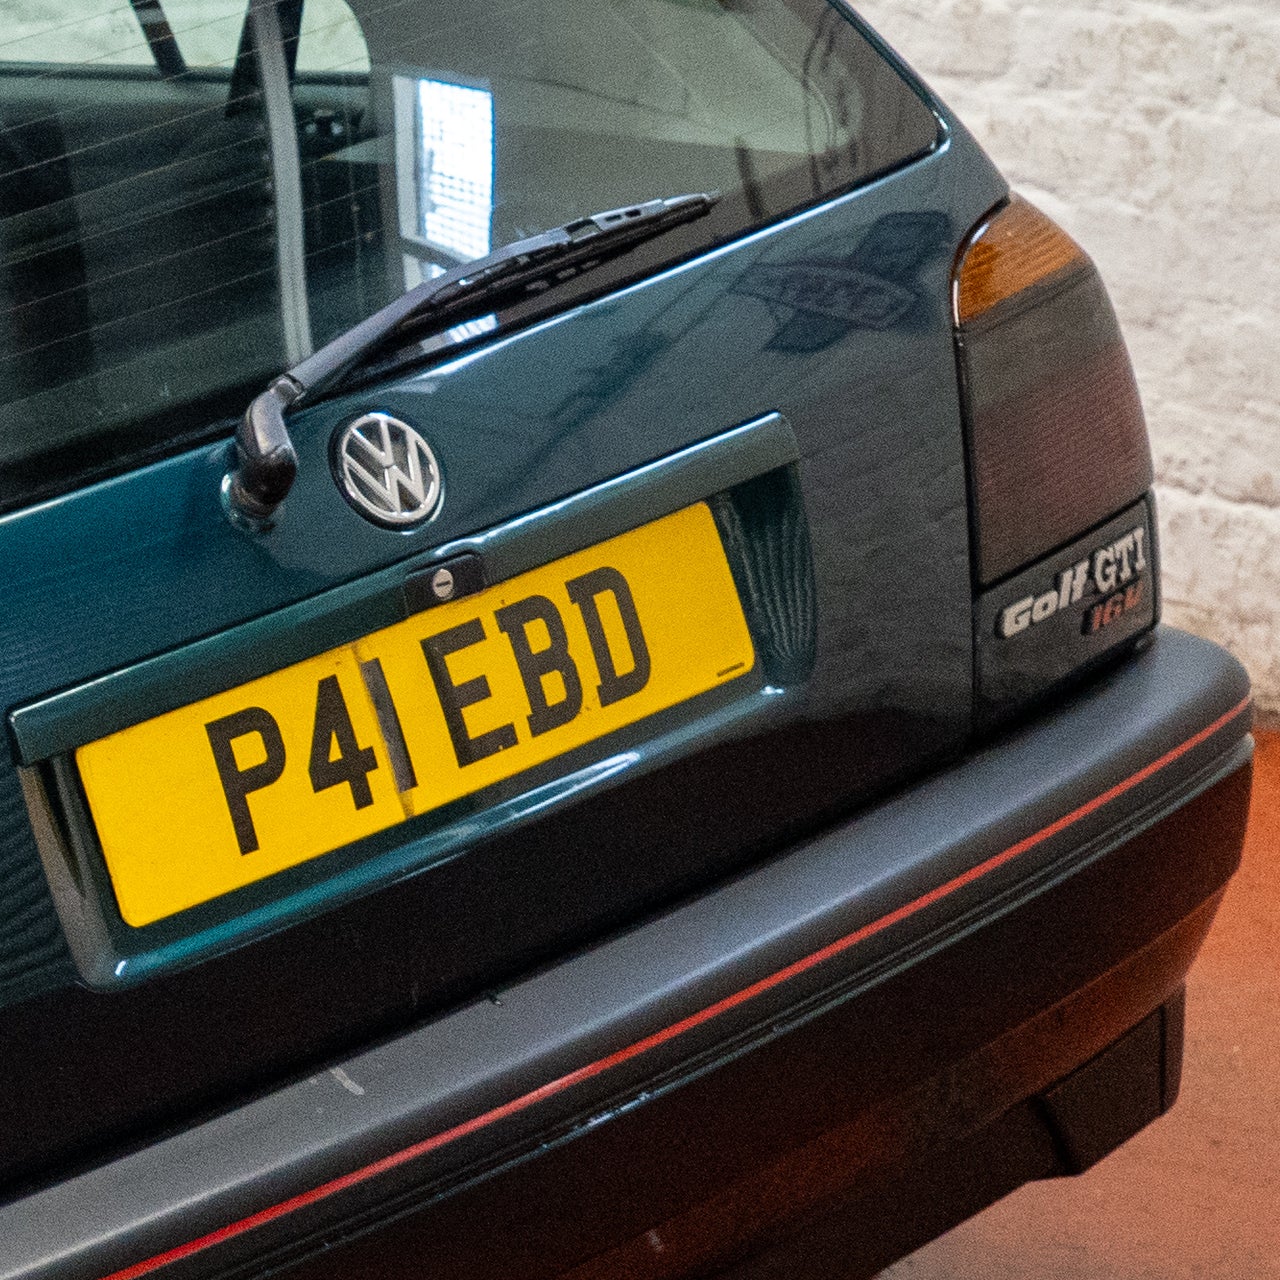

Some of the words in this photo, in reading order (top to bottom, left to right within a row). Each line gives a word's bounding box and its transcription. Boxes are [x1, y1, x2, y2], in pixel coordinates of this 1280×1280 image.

[1001, 557, 1090, 638] Golf
[1093, 527, 1146, 594] GTI
[206, 656, 418, 856] P41
[419, 565, 653, 768] EBD
